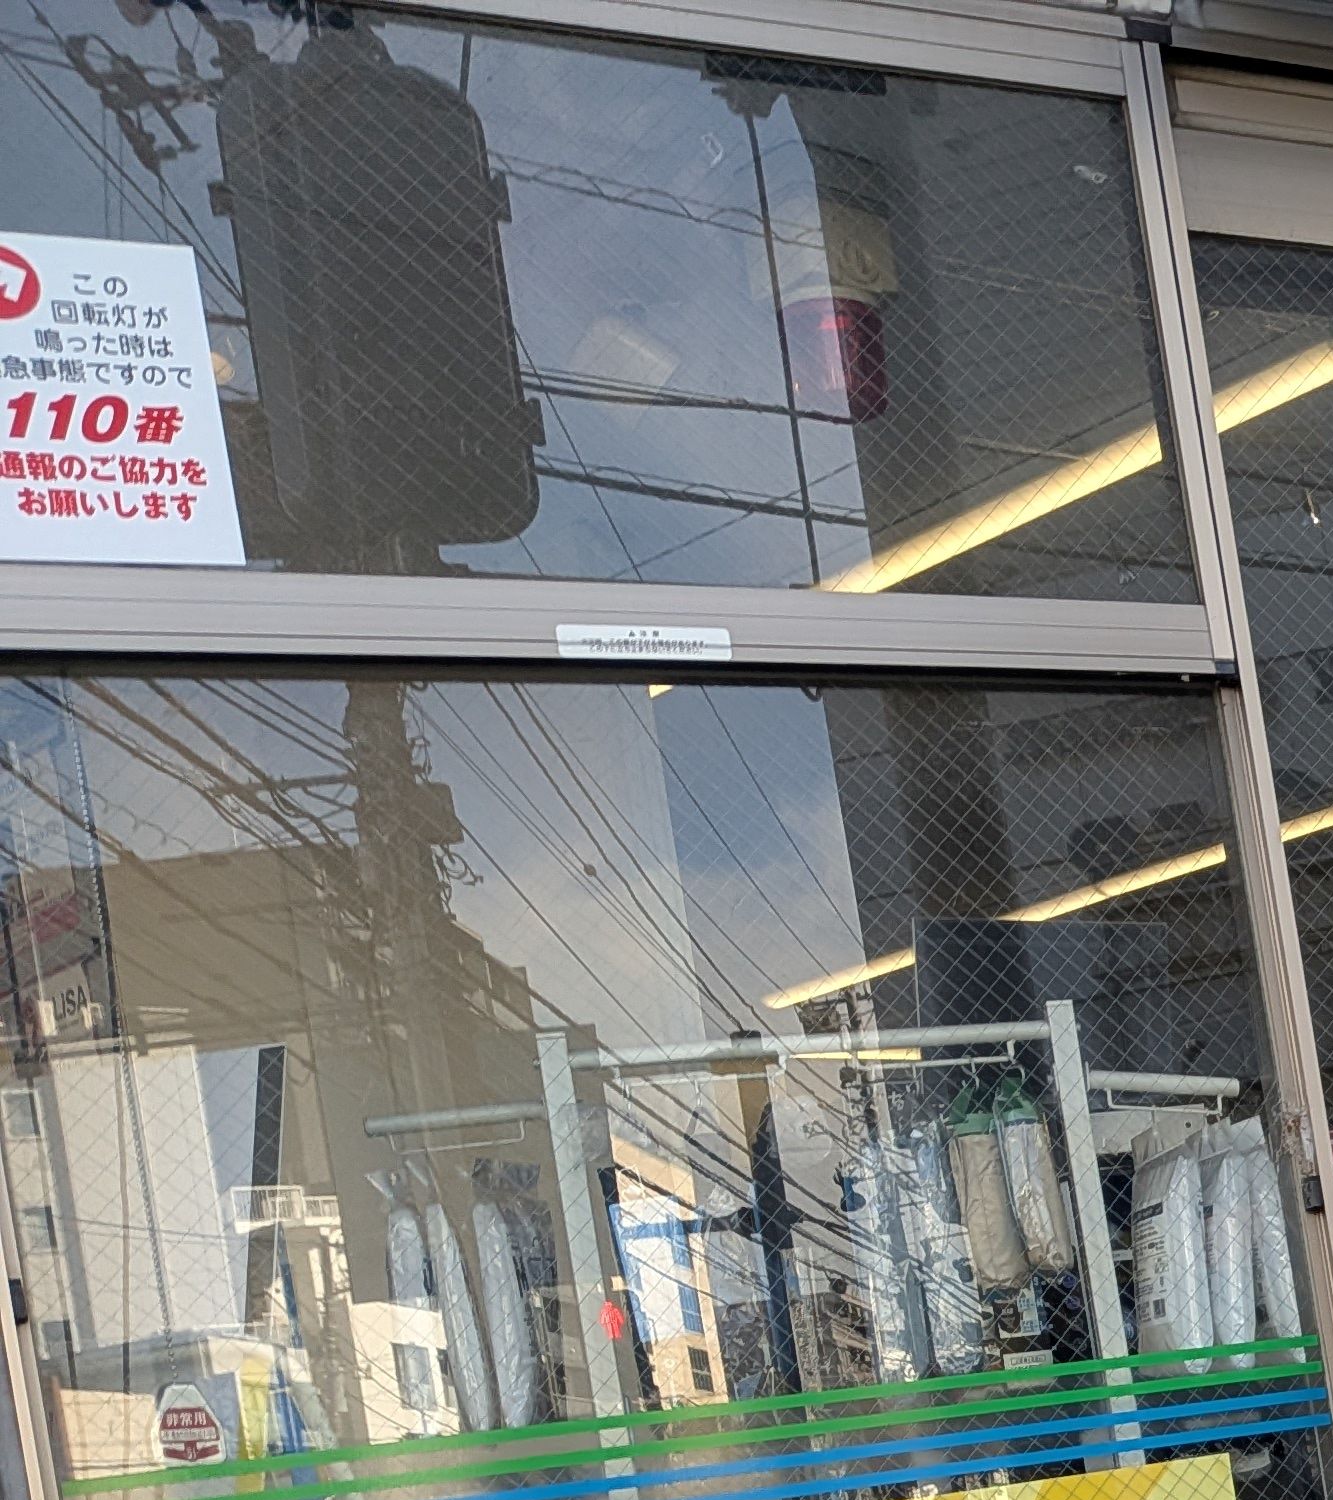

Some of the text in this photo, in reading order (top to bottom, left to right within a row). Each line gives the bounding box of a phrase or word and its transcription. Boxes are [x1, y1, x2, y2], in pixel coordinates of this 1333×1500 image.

[72, 273, 129, 297] この
[51, 300, 168, 329] 回転灯が
[34, 329, 173, 357] 鳴った時は
[0, 355, 192, 389] 急事態ですので
[7, 391, 184, 446] 110番
[0, 451, 207, 486] 通報のご協力を
[17, 487, 198, 521] お願いします
[165, 1411, 208, 1428] 非常用
